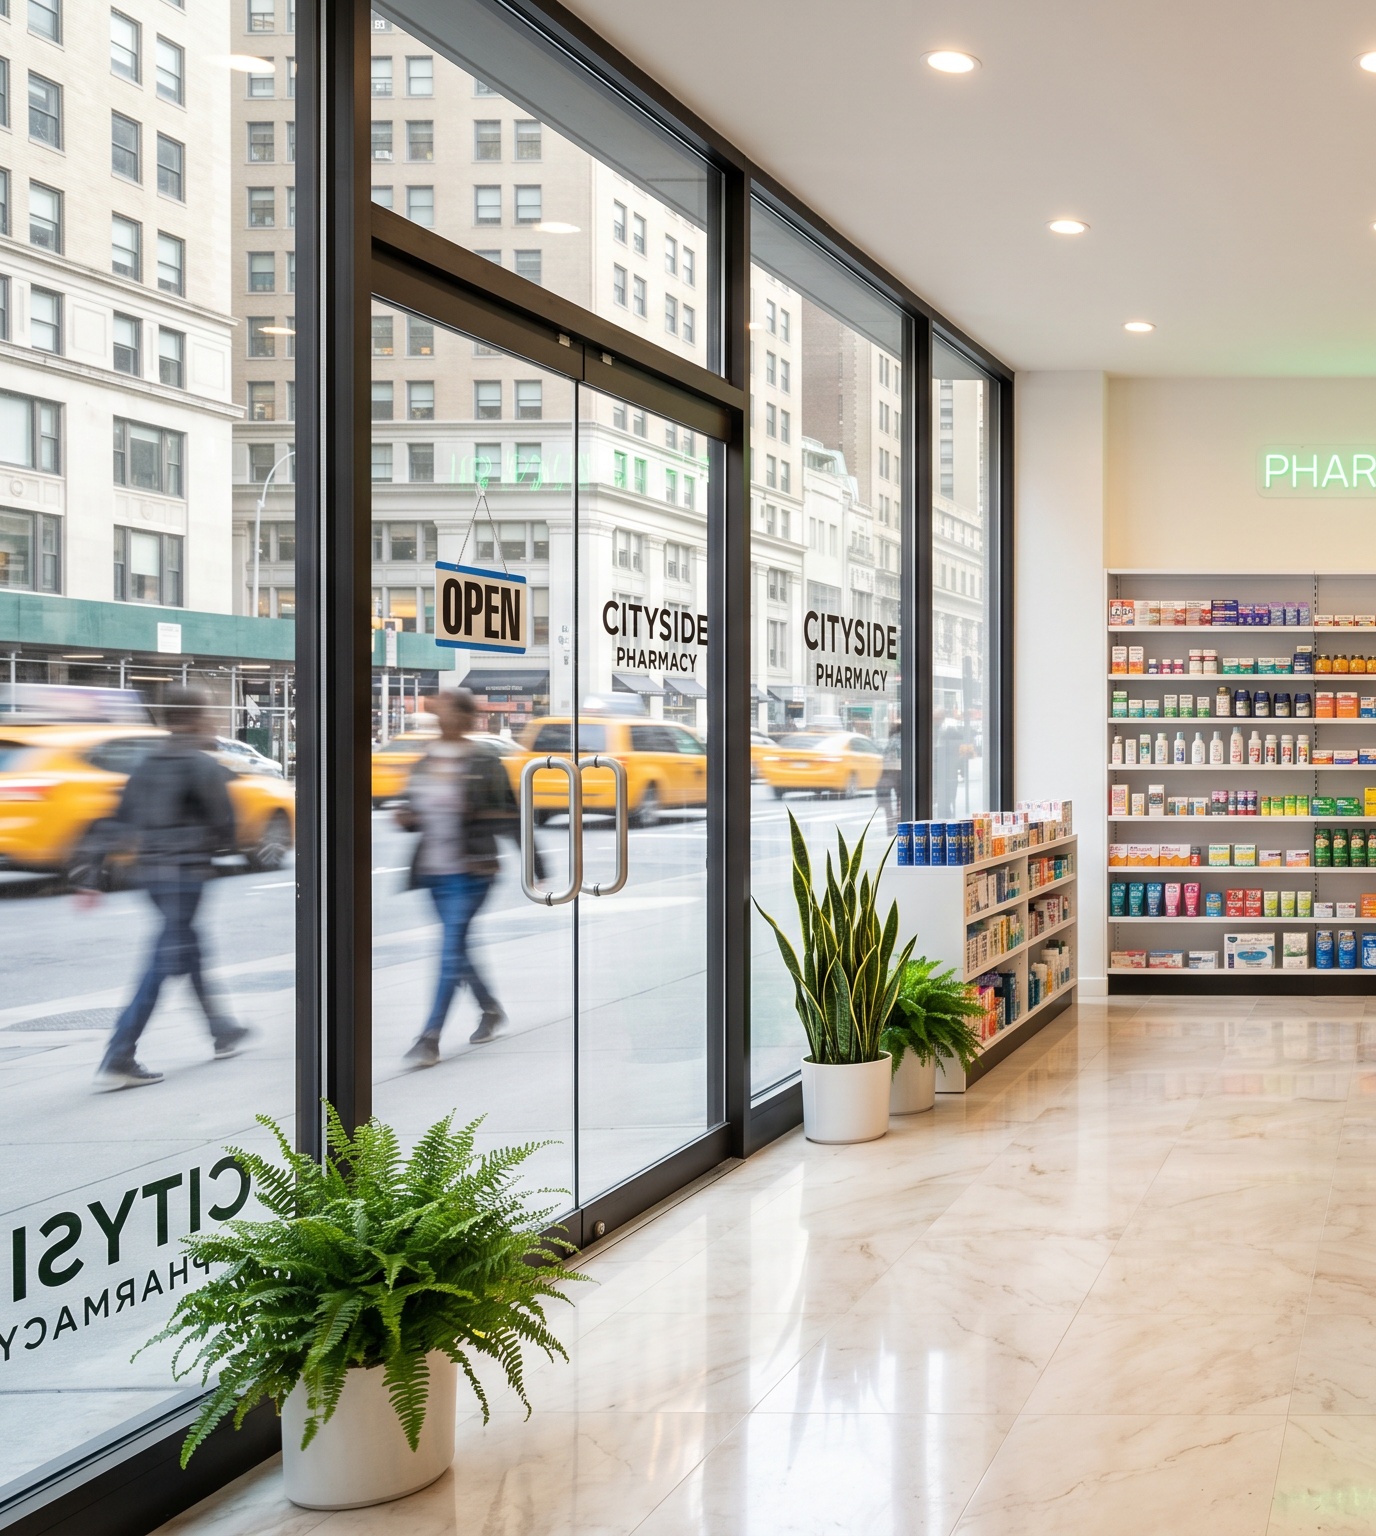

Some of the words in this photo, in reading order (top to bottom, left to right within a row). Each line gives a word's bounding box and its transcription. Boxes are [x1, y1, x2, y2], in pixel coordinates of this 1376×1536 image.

[442, 578, 520, 642] OPEN
[602, 600, 708, 646] CITYSIDE
[804, 610, 898, 660] CITYSIDE
[616, 646, 698, 672] PHARMACY
[816, 662, 888, 692] PHARMACY
